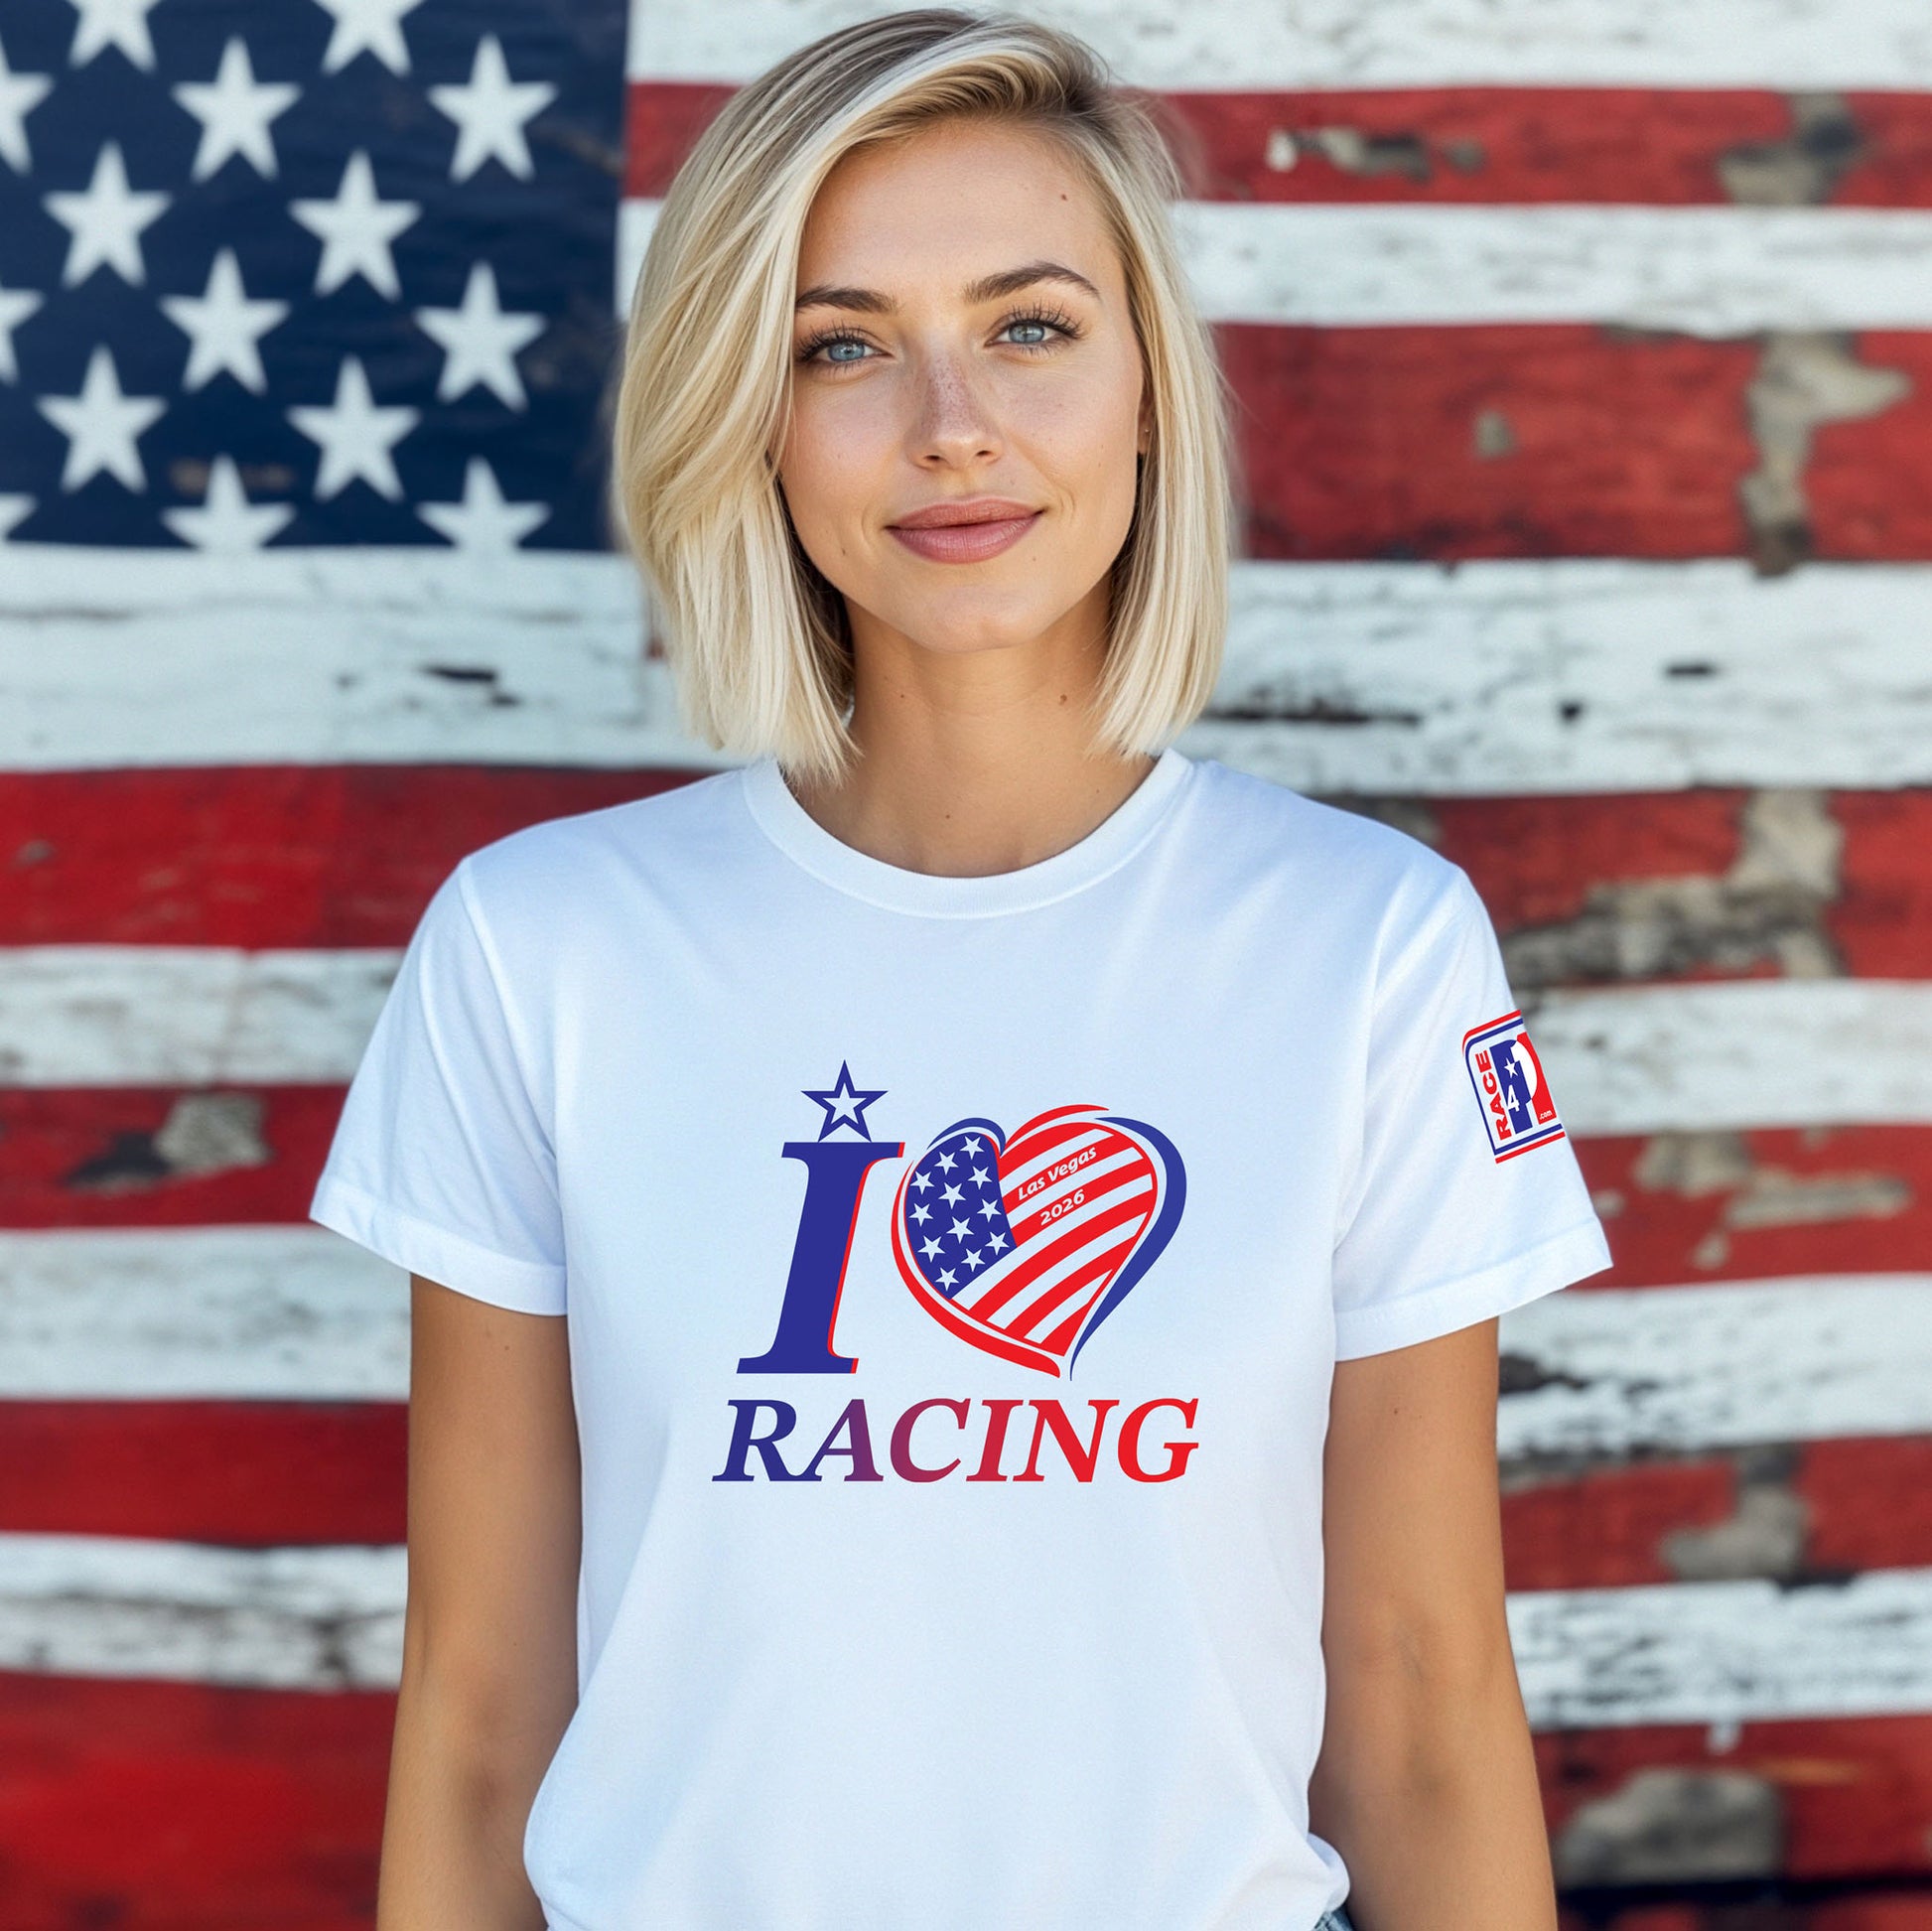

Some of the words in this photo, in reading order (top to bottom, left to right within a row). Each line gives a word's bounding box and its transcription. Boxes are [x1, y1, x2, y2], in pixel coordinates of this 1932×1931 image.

[1475, 1050, 1512, 1140] RACE
[1507, 1084, 1520, 1112] 4
[1539, 1109, 1554, 1120] .com
[1018, 1176, 1045, 1200] Las
[1047, 1147, 1097, 1182] Vegas
[1039, 1188, 1085, 1226] 2026
[736, 1141, 905, 1374] I
[711, 1397, 1199, 1483] RACING
